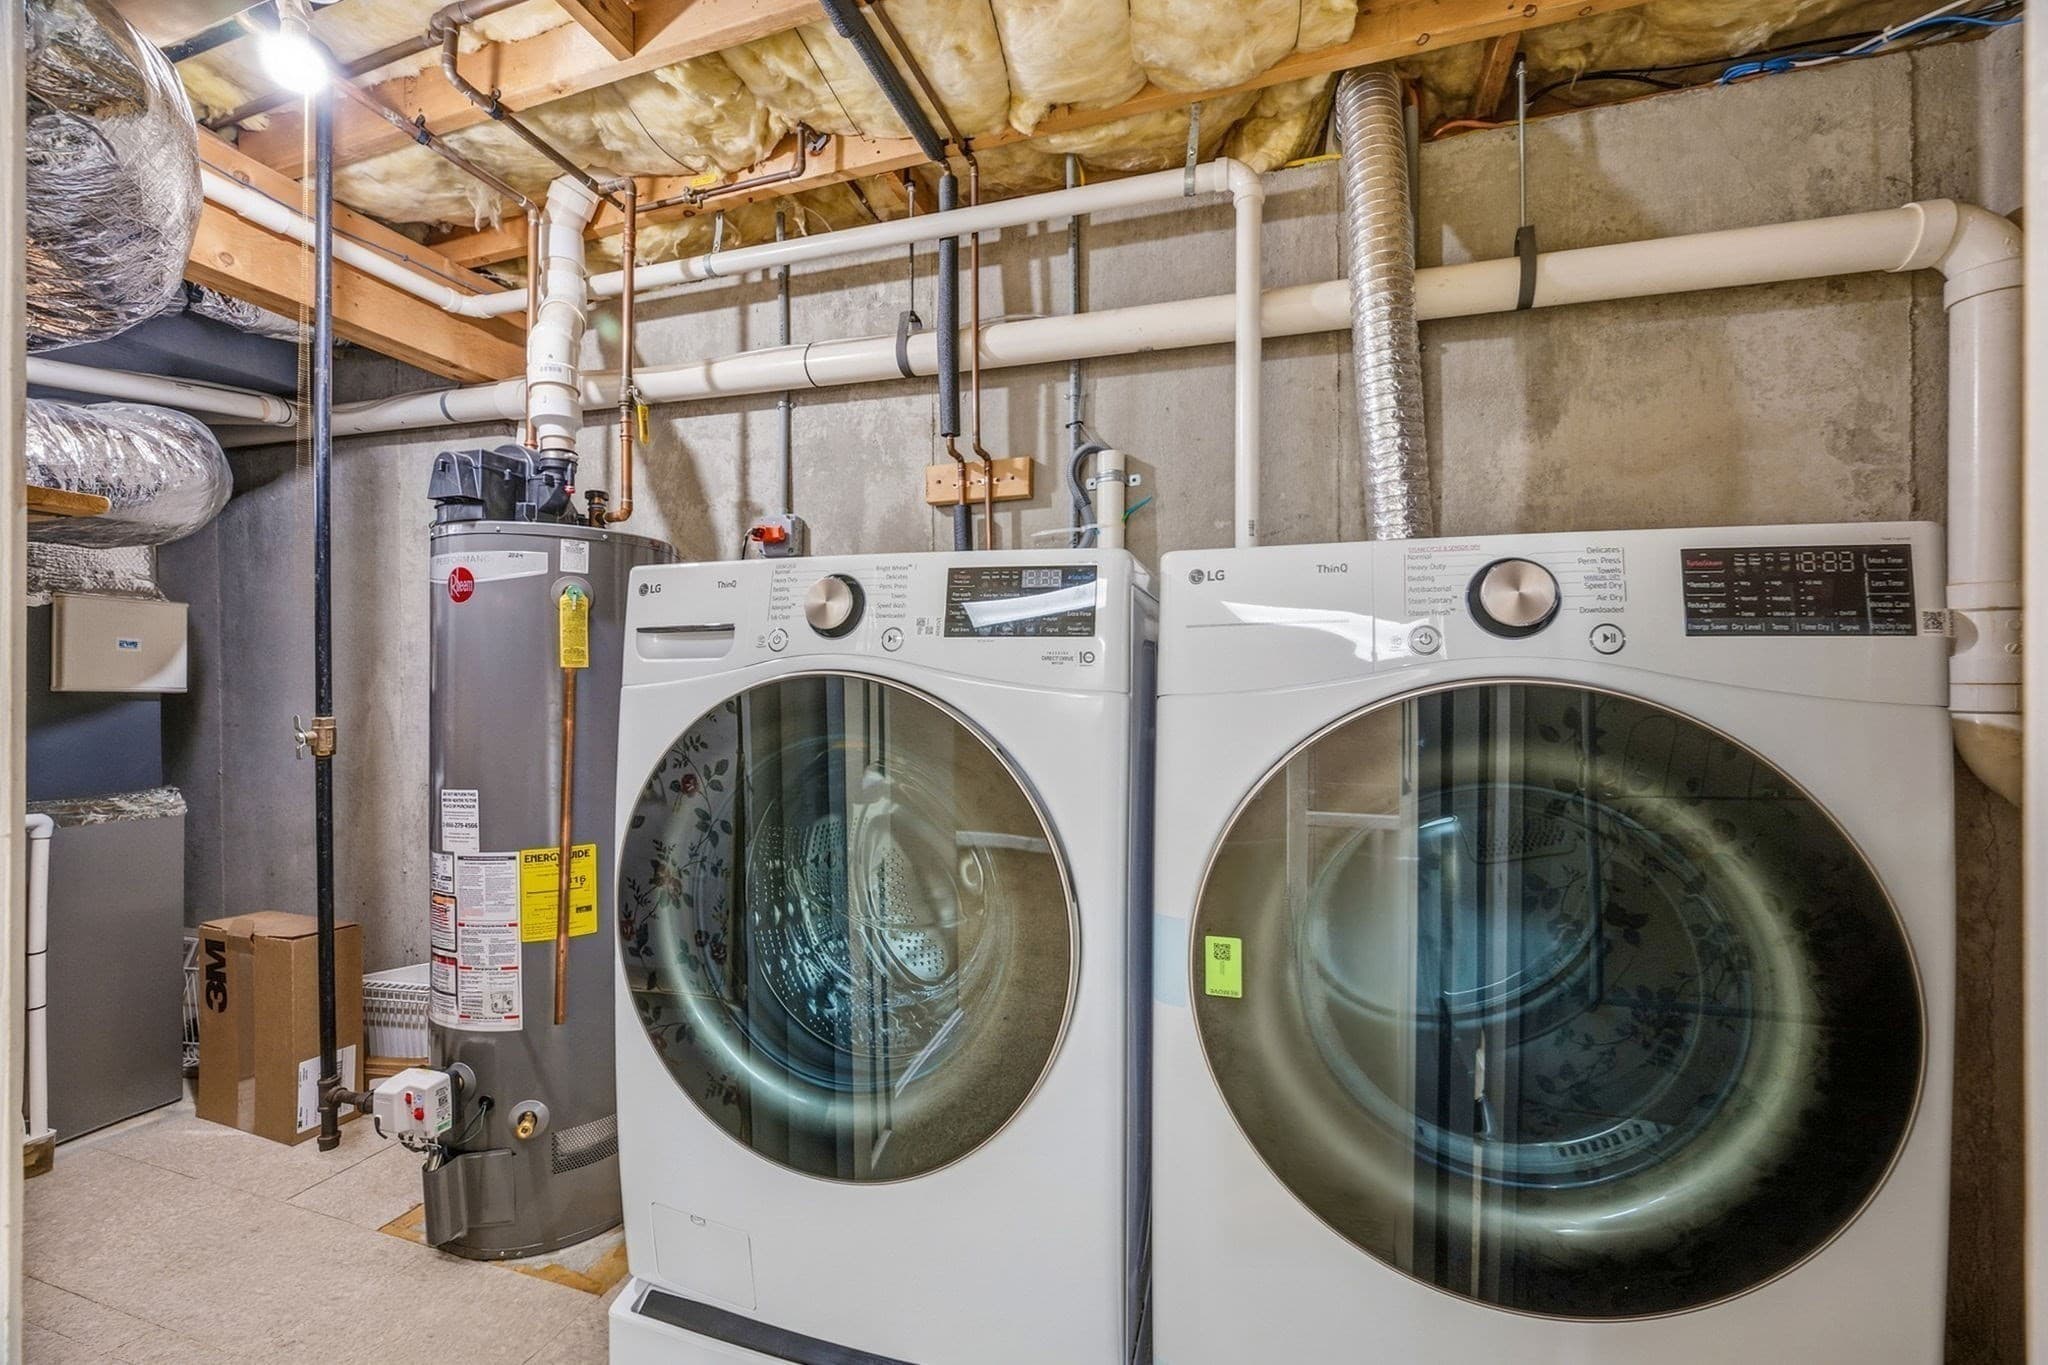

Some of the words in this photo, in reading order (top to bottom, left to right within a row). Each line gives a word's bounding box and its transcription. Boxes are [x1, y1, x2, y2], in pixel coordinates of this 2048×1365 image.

[1316, 563, 1348, 573] ThinQ
[1430, 563, 1446, 571] Duty
[1207, 570, 1225, 581] LG
[450, 568, 473, 597] Rheem
[717, 580, 736, 589] ThinQ
[650, 583, 661, 594] LG
[1609, 594, 1623, 602] Dry
[1731, 624, 1743, 632] Dry
[205, 939, 227, 1013] 3M
